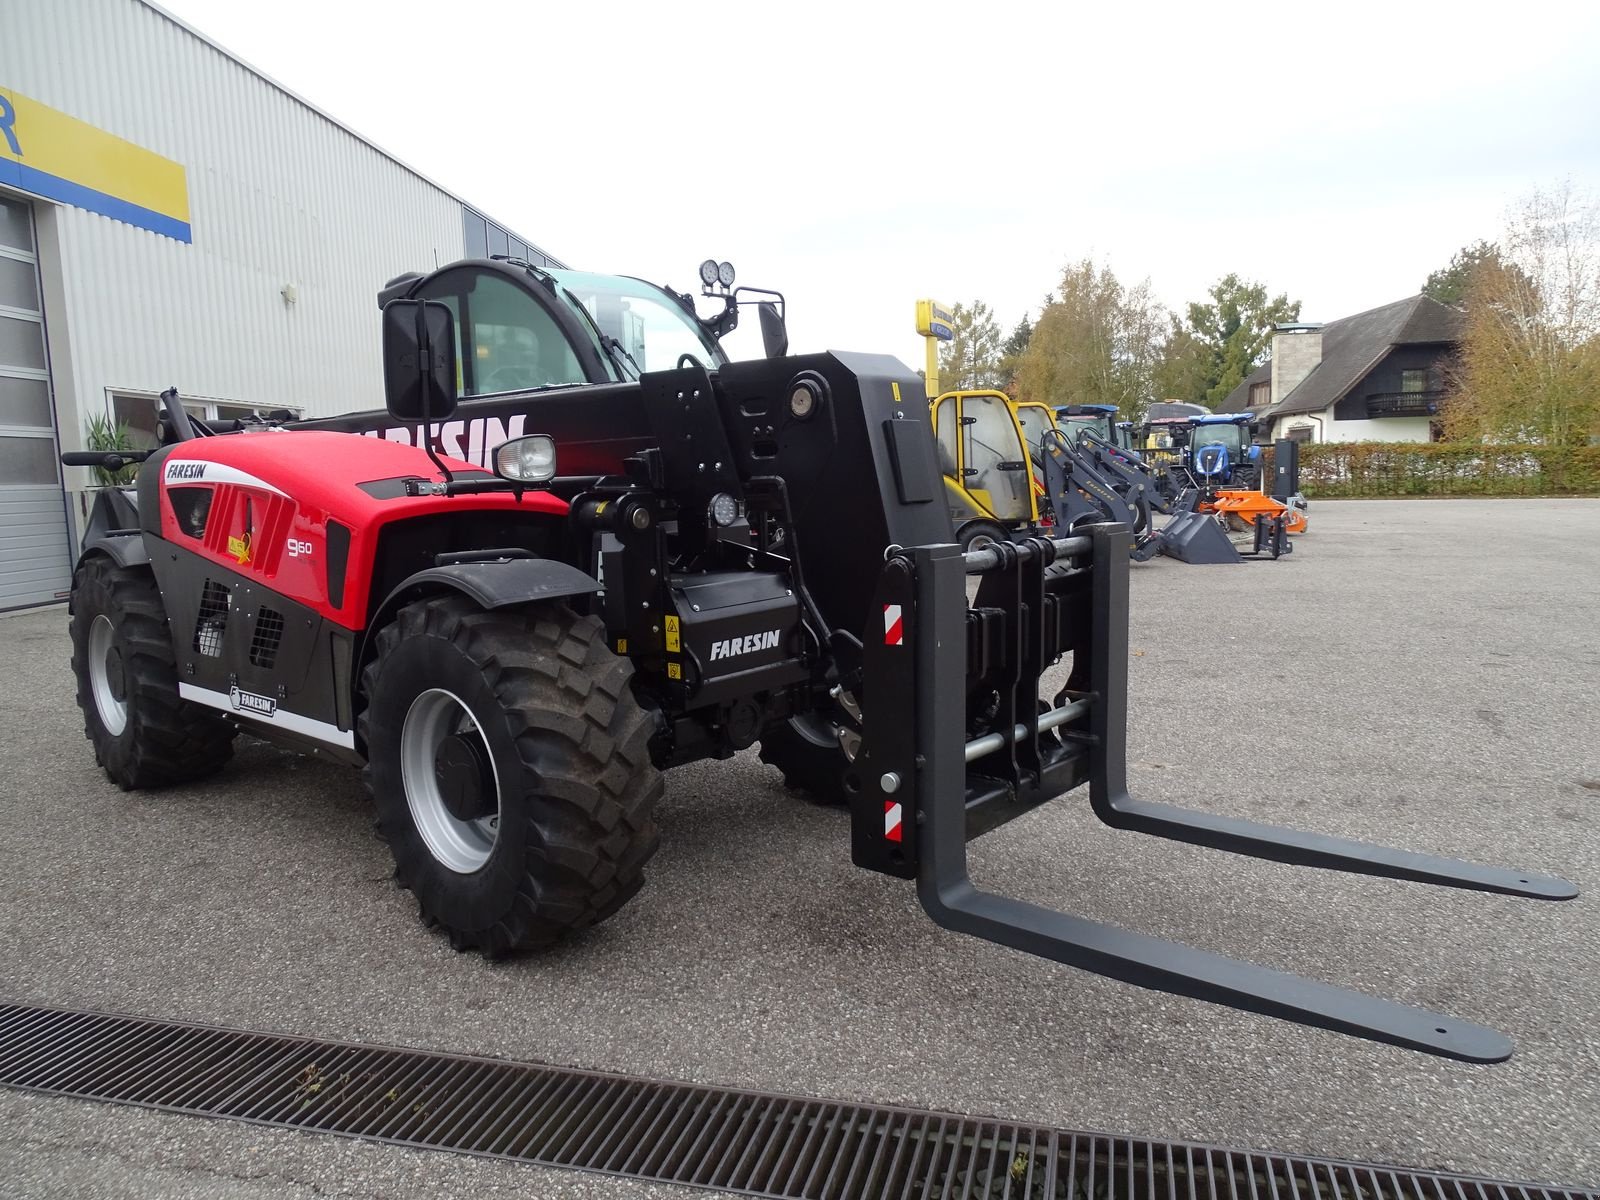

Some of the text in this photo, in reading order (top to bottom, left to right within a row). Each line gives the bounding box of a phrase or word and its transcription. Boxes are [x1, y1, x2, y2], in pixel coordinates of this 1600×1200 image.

[167, 464, 207, 479] FARESIN
[287, 538, 313, 557] 960
[710, 629, 781, 662] FARESIN
[241, 694, 271, 711] FARESIN
